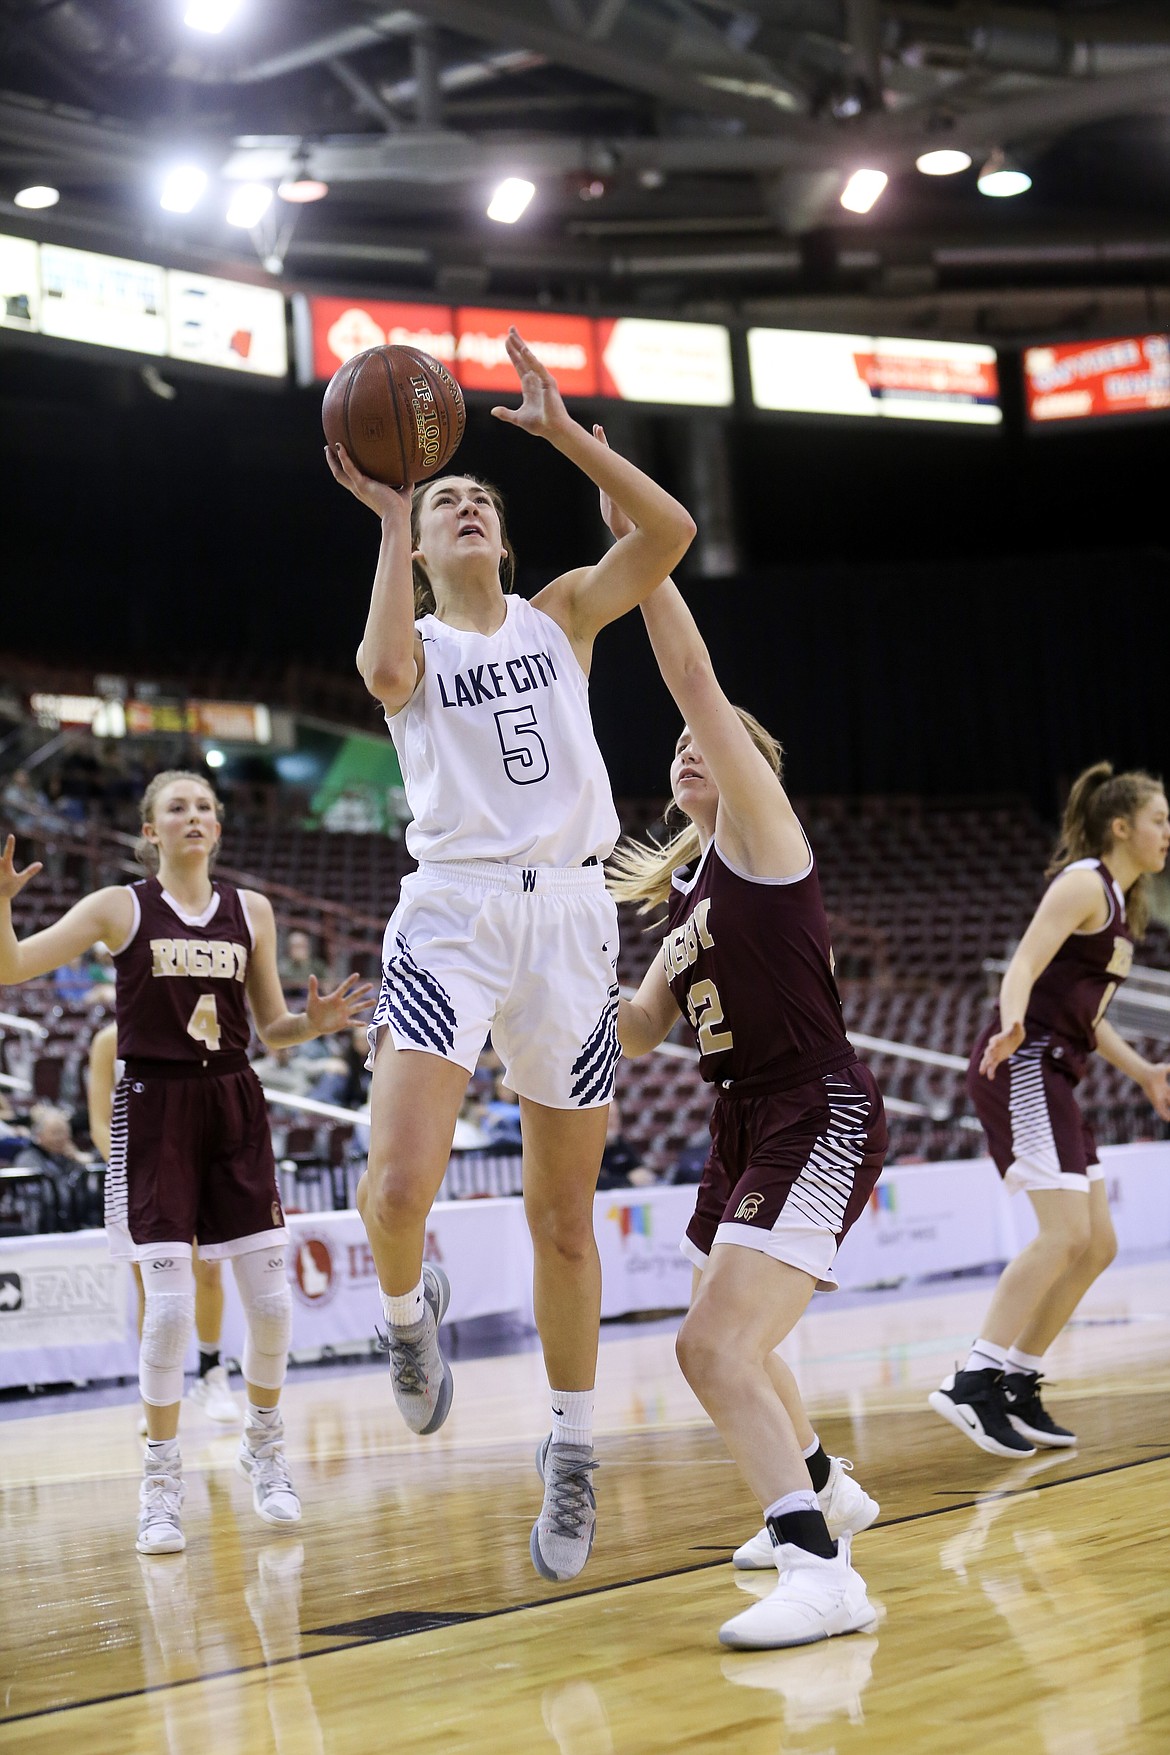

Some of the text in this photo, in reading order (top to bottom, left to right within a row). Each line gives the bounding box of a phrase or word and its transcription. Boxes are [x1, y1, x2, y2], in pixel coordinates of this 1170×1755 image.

[411, 398, 426, 434] CLASSIC
[437, 652, 557, 708] LAKE CITY
[494, 705, 549, 785] 5
[522, 870, 536, 893] W
[150, 938, 247, 983] RIGBY
[662, 897, 715, 983] IGBY
[187, 994, 221, 1051] 4
